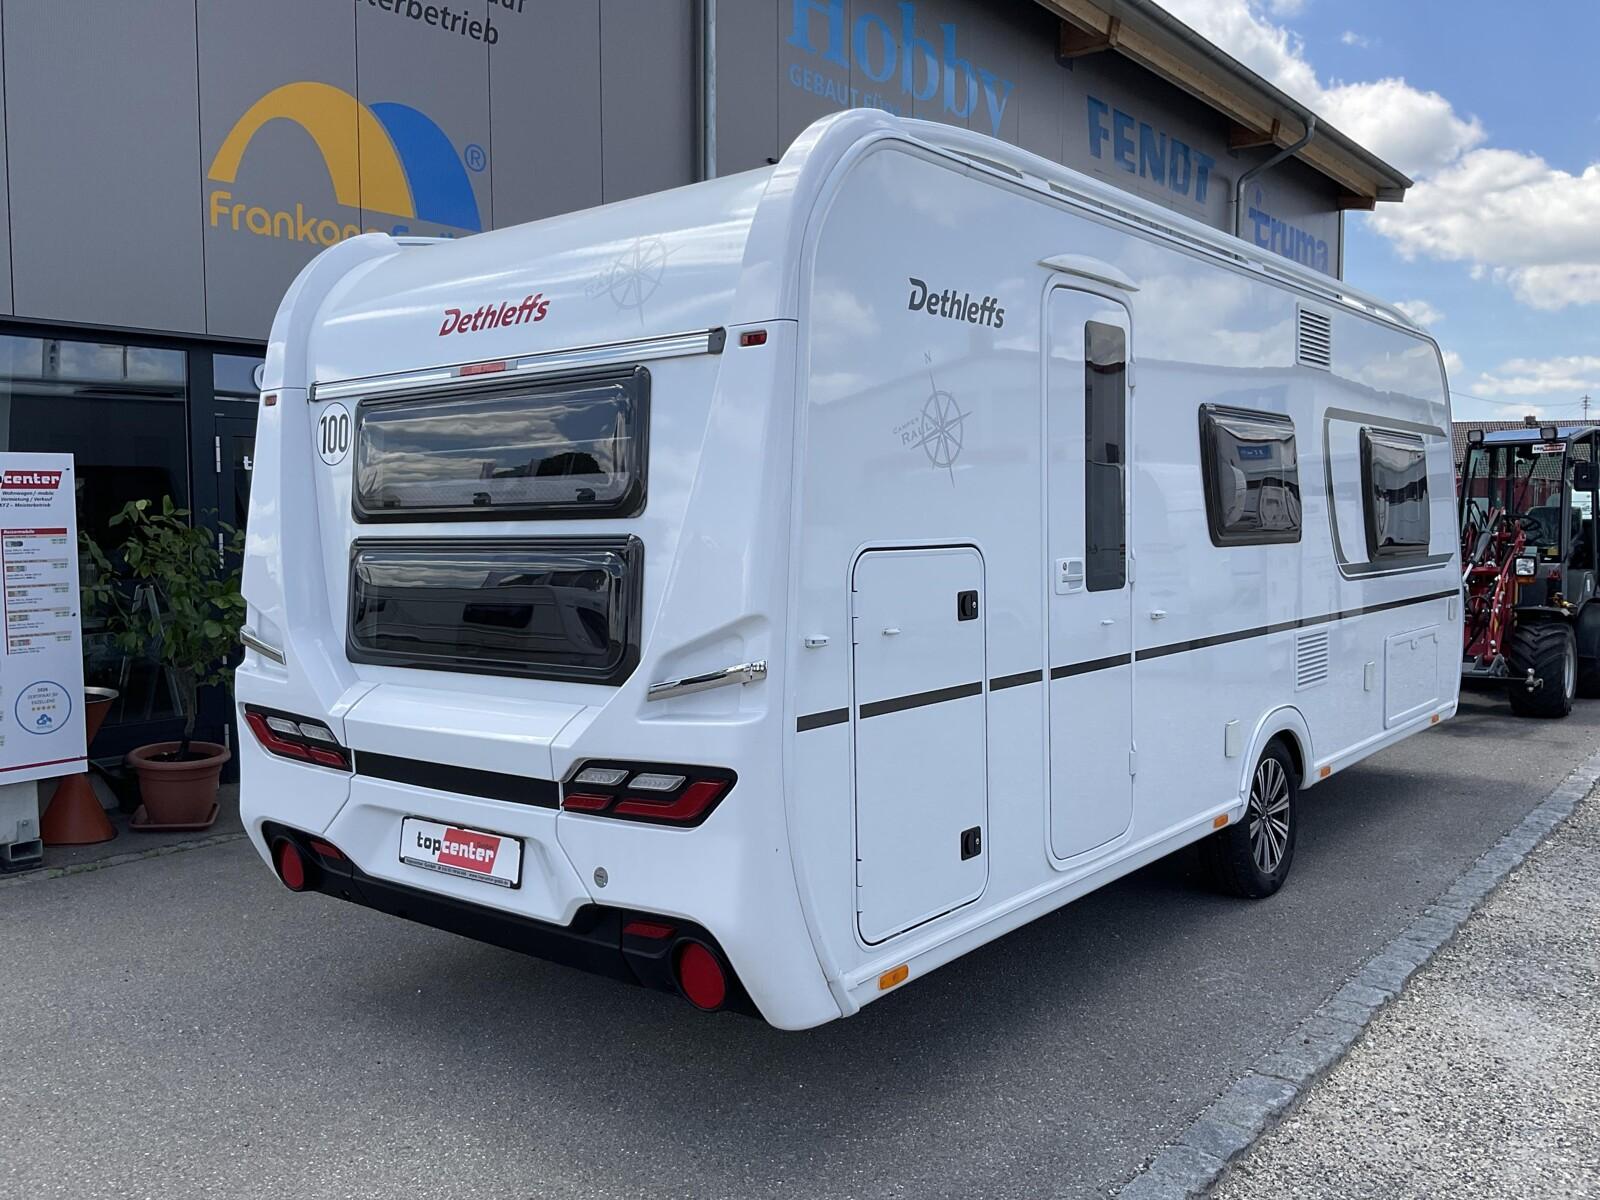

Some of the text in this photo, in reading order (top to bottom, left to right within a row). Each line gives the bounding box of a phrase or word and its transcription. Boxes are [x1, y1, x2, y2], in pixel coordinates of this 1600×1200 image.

[786, 0, 1015, 138] Hobby
[789, 64, 859, 109] GEBAUT
[1087, 95, 1216, 204] FENDT
[1248, 195, 1329, 275] truma
[438, 293, 551, 337] Dethleffs
[908, 277, 1005, 328] Dethleffs
[320, 413, 349, 455] 100
[416, 831, 495, 863] topcenter
